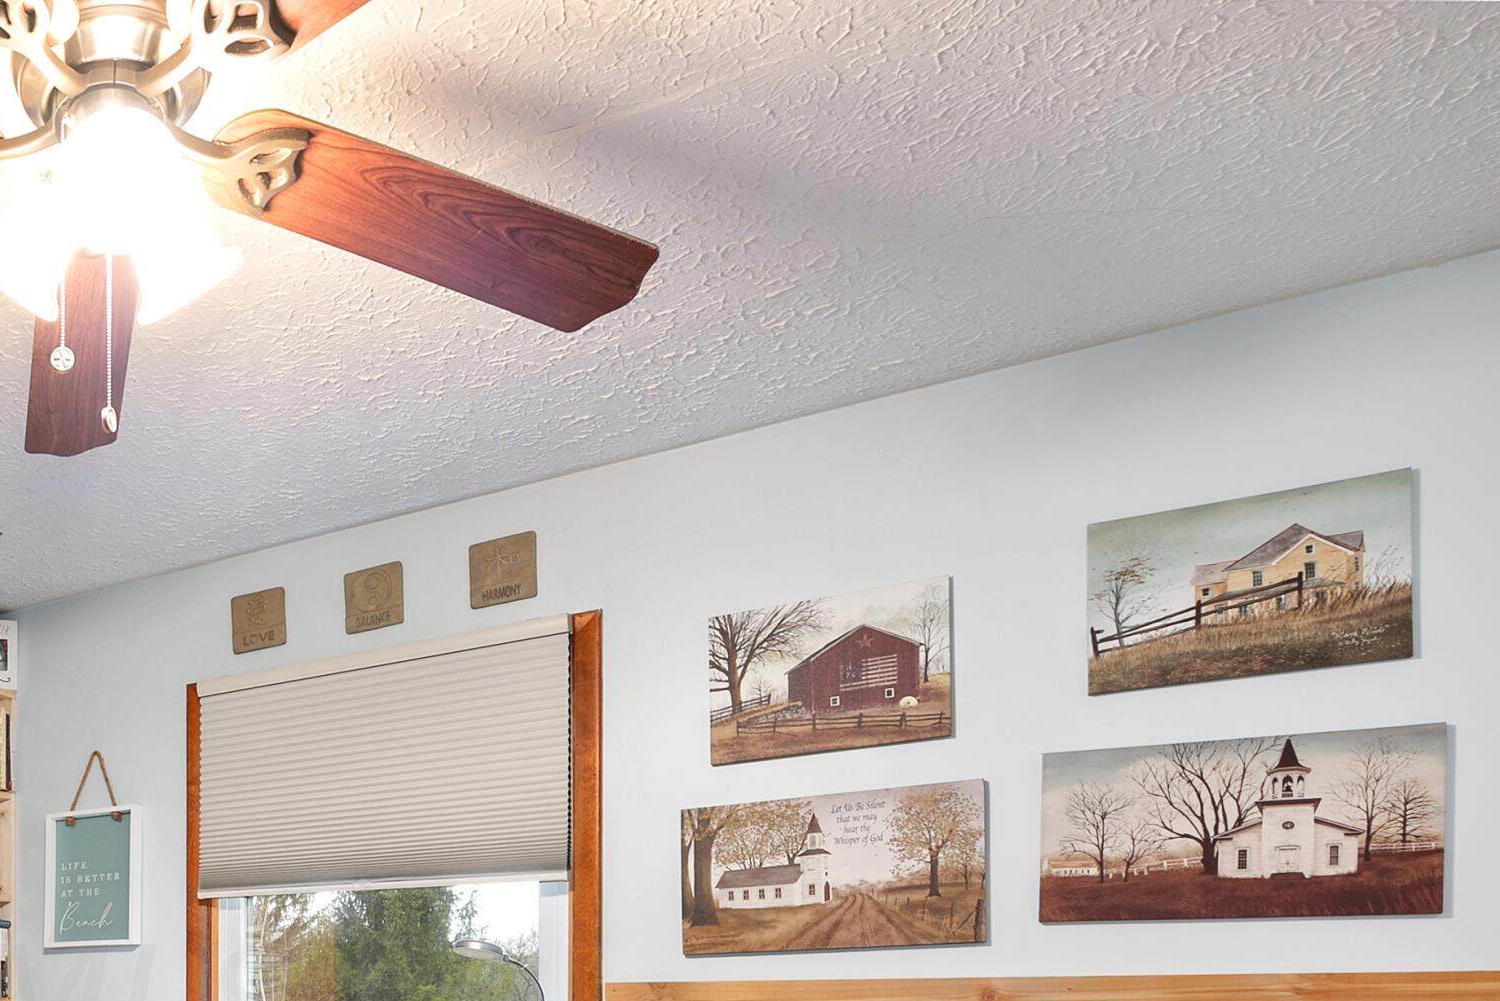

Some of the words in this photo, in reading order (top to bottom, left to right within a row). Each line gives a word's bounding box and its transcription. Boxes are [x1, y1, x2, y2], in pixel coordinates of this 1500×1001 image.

[482, 583, 521, 602] HARMONY
[356, 610, 390, 629] BALANCE
[243, 630, 275, 647] LOVE
[830, 805, 842, 814] Let
[845, 803, 854, 812] Us
[856, 802, 865, 811] Be
[866, 799, 886, 810] Silent
[837, 815, 851, 824] that
[862, 814, 877, 824] may
[844, 825, 858, 833] hear
[860, 824, 871, 832] the
[861, 834, 869, 845] of
[869, 833, 883, 845] God
[61, 861, 88, 871] LIFE
[61, 875, 71, 884] IS
[77, 872, 120, 883] BETTER
[61, 888, 73, 898] AT
[79, 887, 101, 897] THE
[60, 901, 113, 934] Beach
